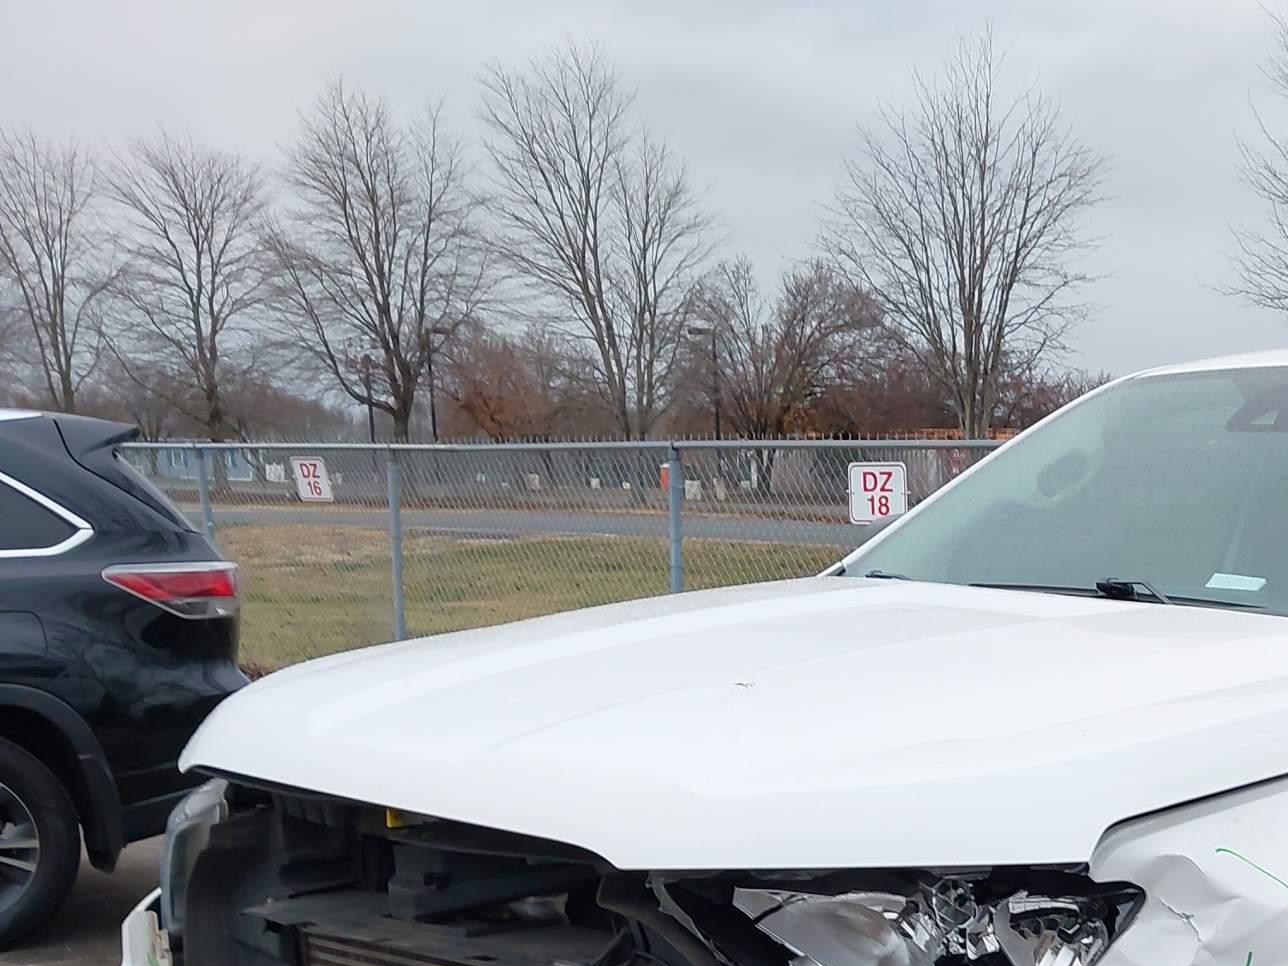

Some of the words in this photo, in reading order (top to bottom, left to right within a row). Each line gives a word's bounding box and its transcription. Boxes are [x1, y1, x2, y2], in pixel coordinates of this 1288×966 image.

[299, 463, 321, 478] DZ
[307, 480, 322, 496] 16
[862, 471, 894, 492] DZ
[867, 495, 890, 516] 18
